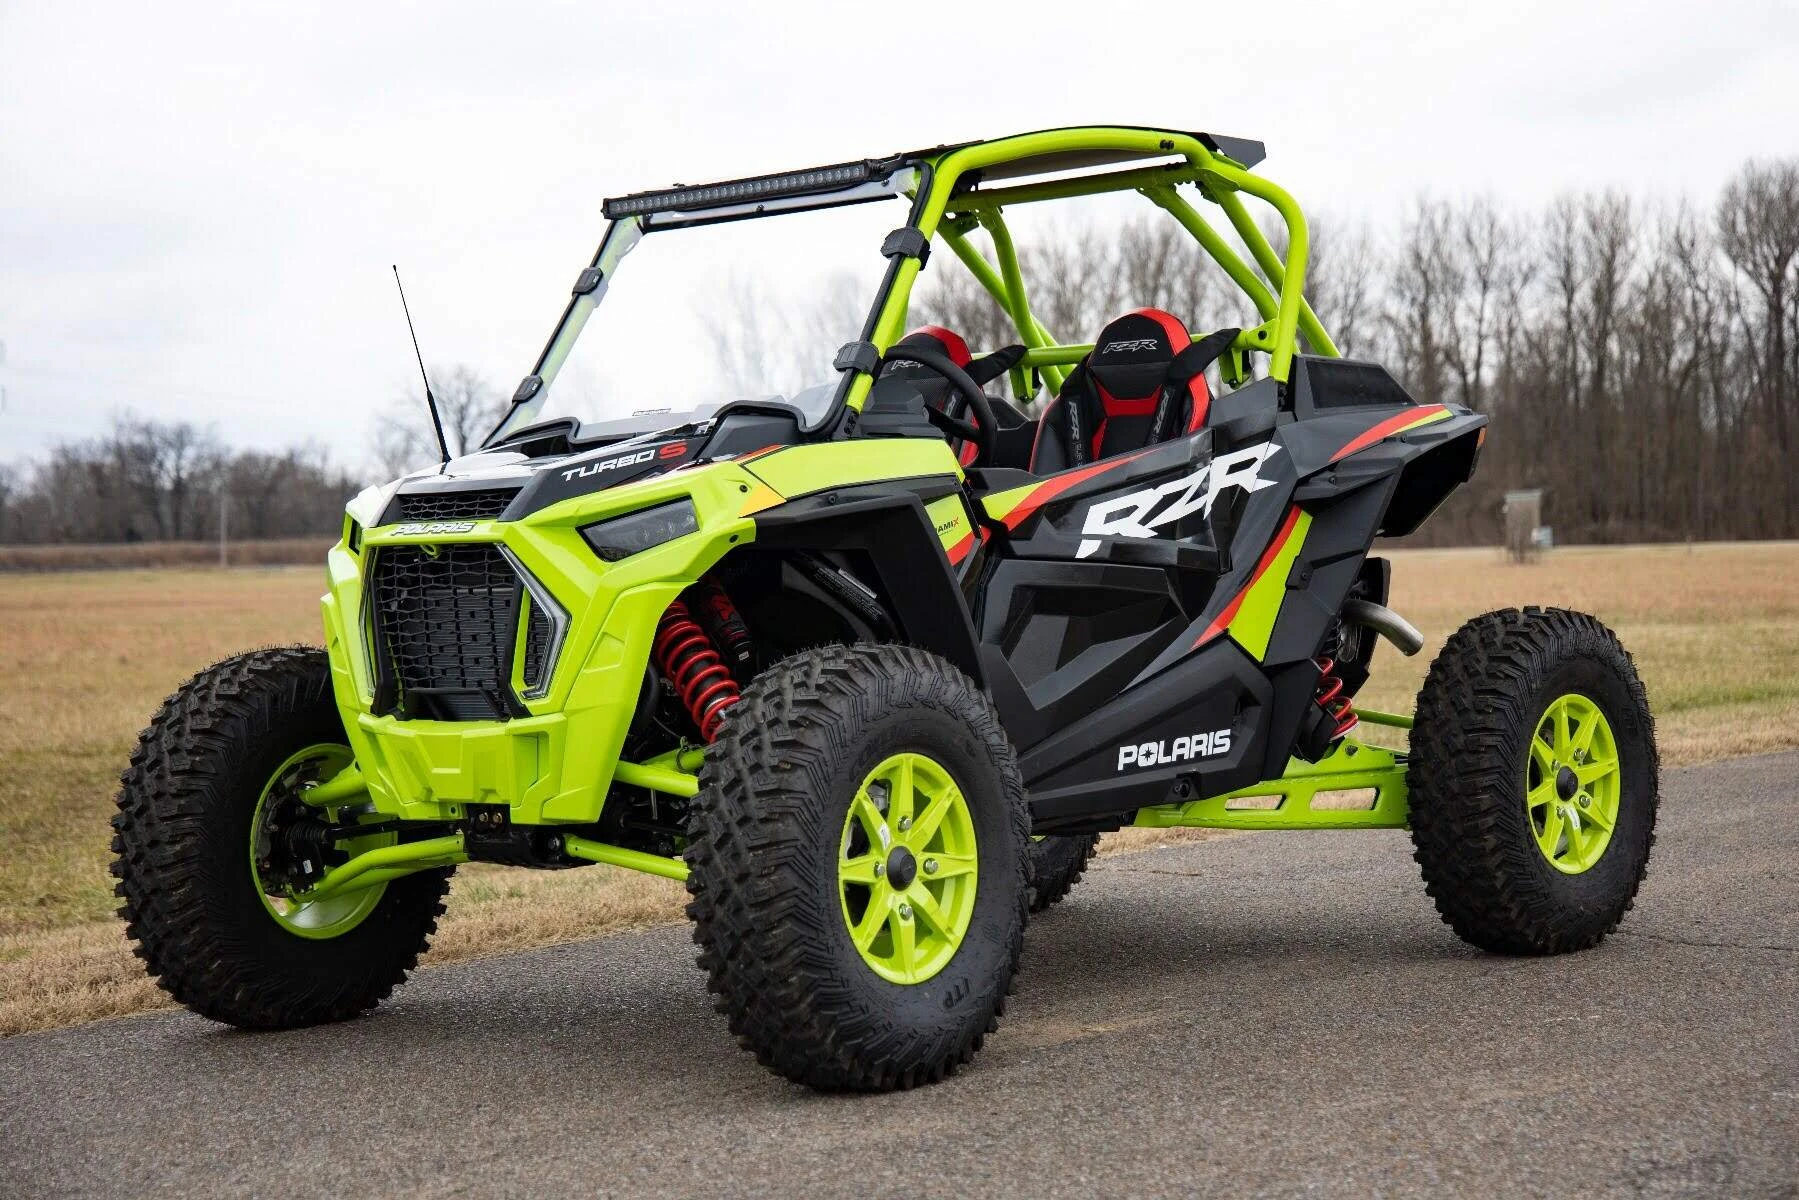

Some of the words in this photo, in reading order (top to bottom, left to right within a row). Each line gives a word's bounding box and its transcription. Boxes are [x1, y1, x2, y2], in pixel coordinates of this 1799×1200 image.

[1102, 339, 1158, 354] RZR
[1068, 401, 1081, 441] RZR
[560, 449, 656, 482] TURBO
[657, 441, 688, 460] S
[1074, 441, 1283, 559] RZR
[391, 521, 478, 537] POLARIS
[936, 516, 960, 533] AMIX
[1117, 728, 1231, 771] POLARIS
